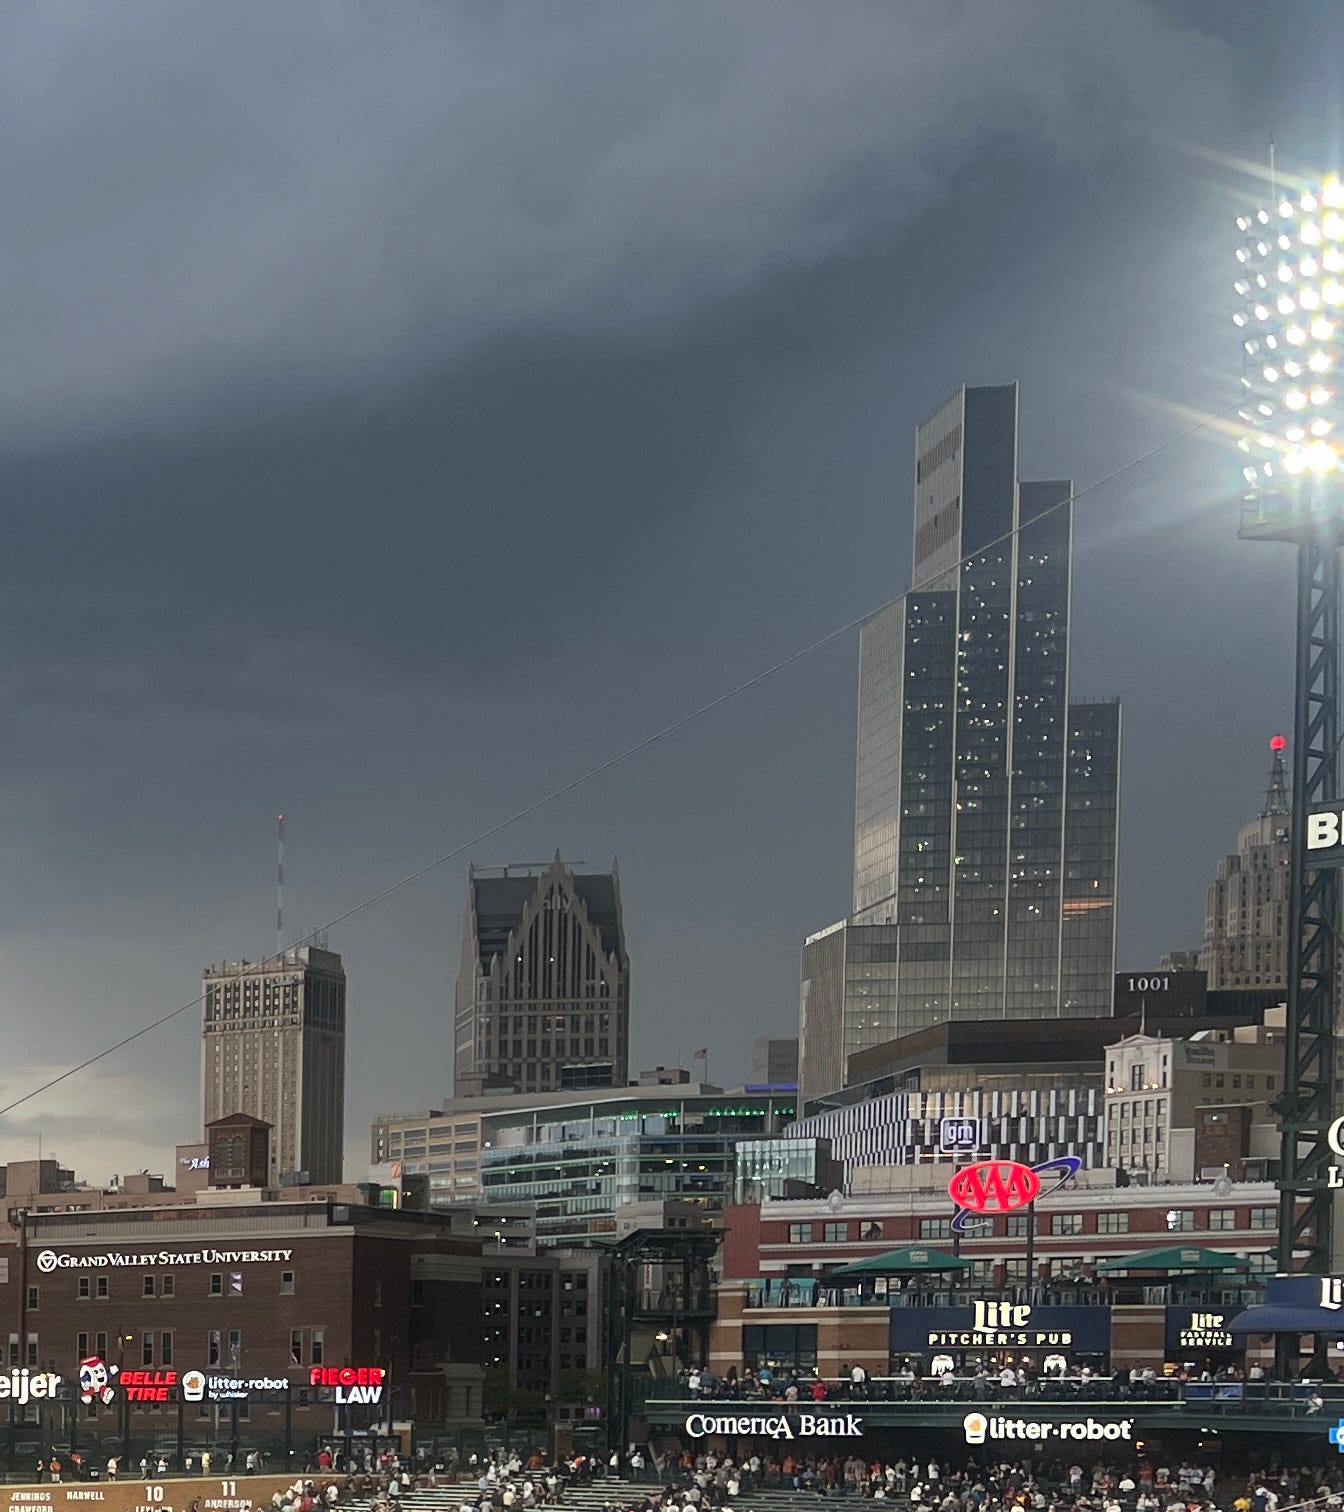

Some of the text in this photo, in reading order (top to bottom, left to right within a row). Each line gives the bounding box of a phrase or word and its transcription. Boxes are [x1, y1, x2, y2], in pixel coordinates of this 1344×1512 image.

[1128, 978, 1170, 992] 1001
[947, 1125, 973, 1144] gm
[972, 1301, 1031, 1333] Lite
[1191, 1313, 1224, 1331] Lite
[929, 1333, 1072, 1346] PITCHER'S PUB
[119, 1371, 177, 1386] BELLE
[310, 1368, 382, 1386] FIEGER
[126, 1387, 169, 1402] TIRE
[335, 1386, 382, 1404] LAW
[799, 1414, 863, 1437] Bank
[145, 1486, 164, 1501] 10
[221, 1481, 236, 1496] 11
